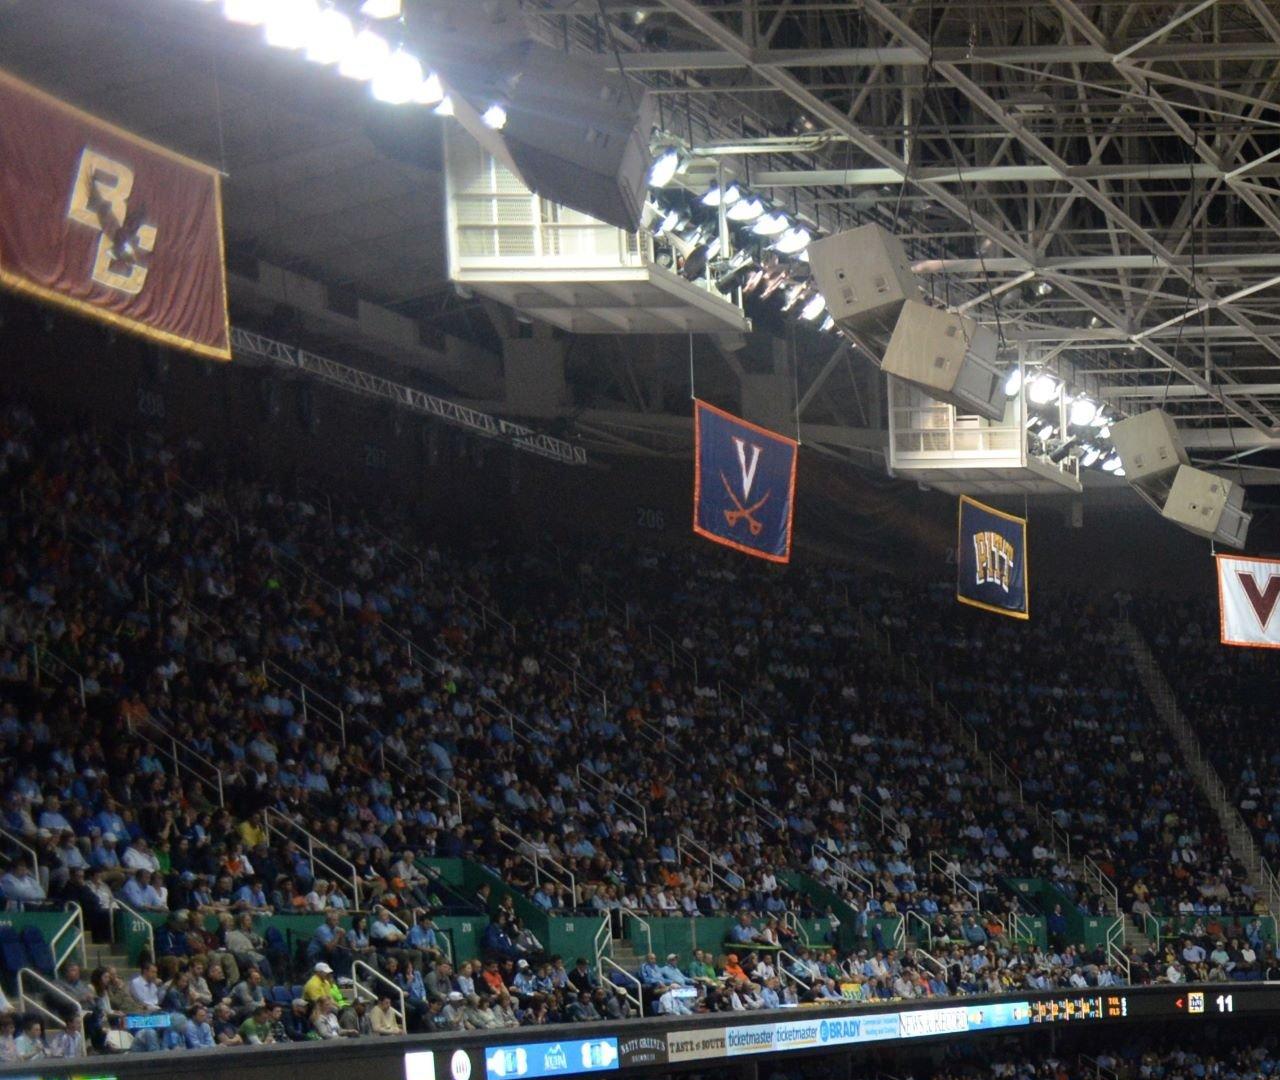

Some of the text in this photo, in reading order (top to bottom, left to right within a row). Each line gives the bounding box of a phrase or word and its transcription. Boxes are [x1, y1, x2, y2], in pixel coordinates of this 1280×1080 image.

[973, 531, 1014, 593] PITT
[1216, 995, 1233, 1012] 11
[728, 1029, 774, 1047] ticketmaster
[776, 1022, 818, 1042] ticketmaster
[829, 1020, 861, 1038] BRADY
